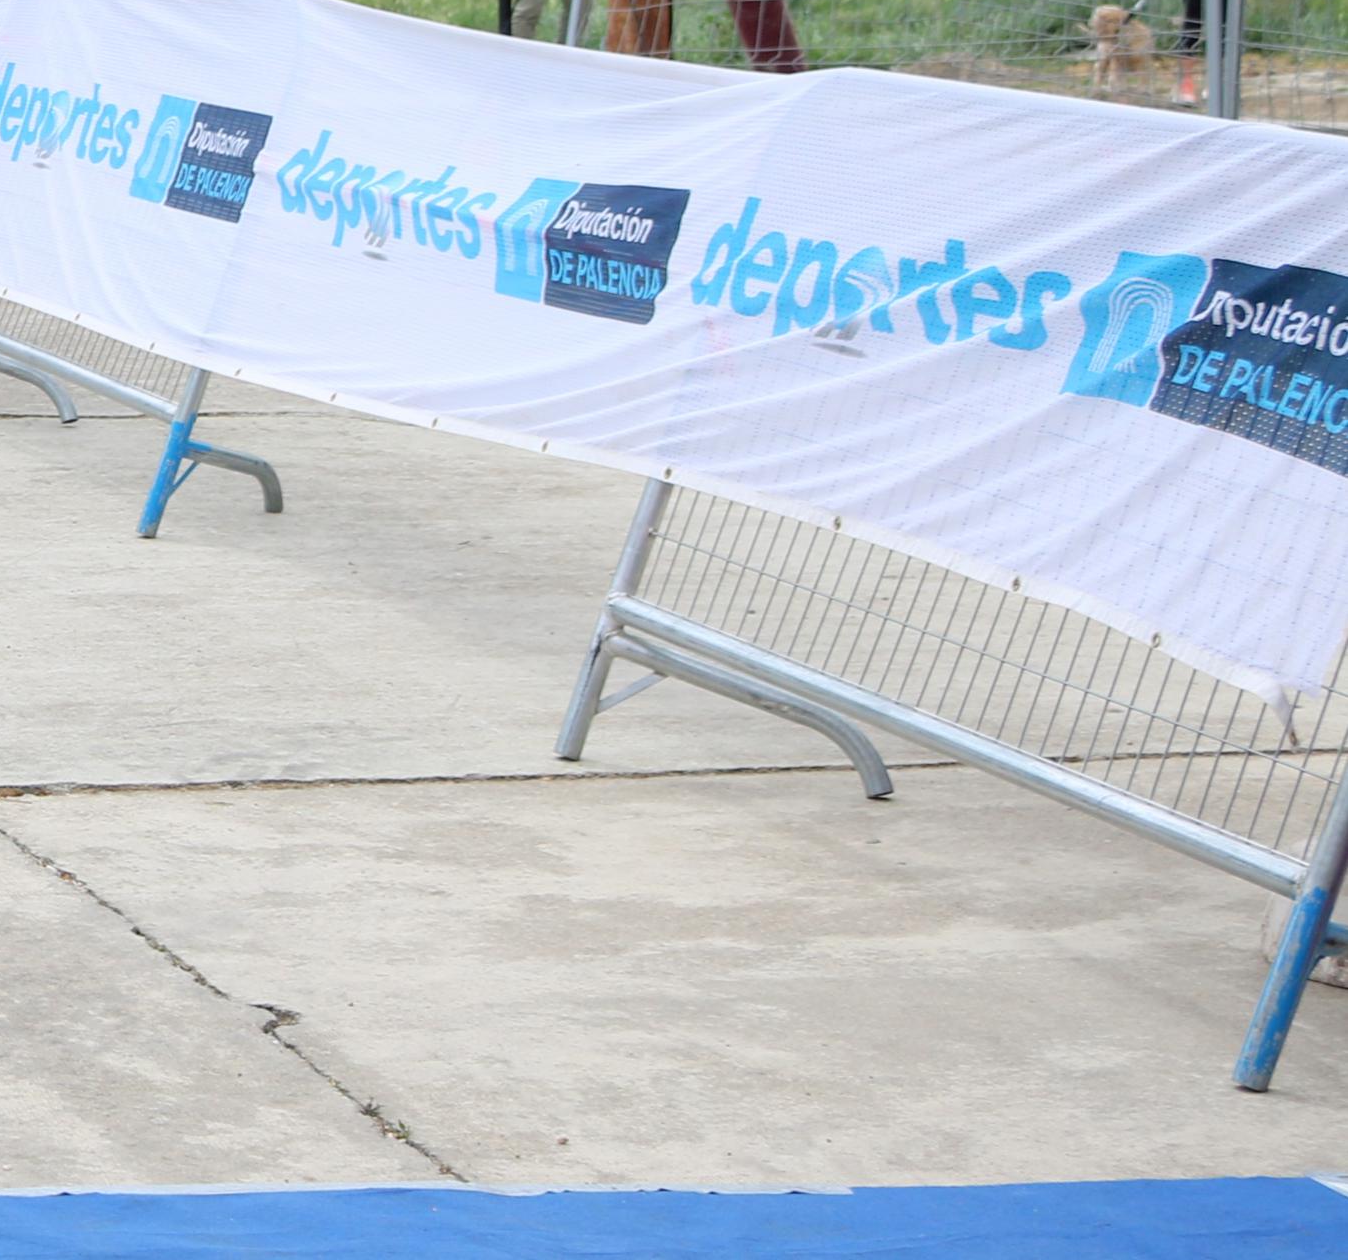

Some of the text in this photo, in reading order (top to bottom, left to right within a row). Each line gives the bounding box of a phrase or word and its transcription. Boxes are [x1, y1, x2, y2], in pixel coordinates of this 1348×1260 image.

[187, 121, 251, 158] Diputación
[174, 163, 253, 203] DE PALENCIA
[276, 129, 497, 260] deportes
[554, 200, 654, 244] Diputación
[549, 248, 666, 300] DE PALENCIA
[691, 196, 1072, 351] deportes
[1171, 344, 1226, 393] DE
